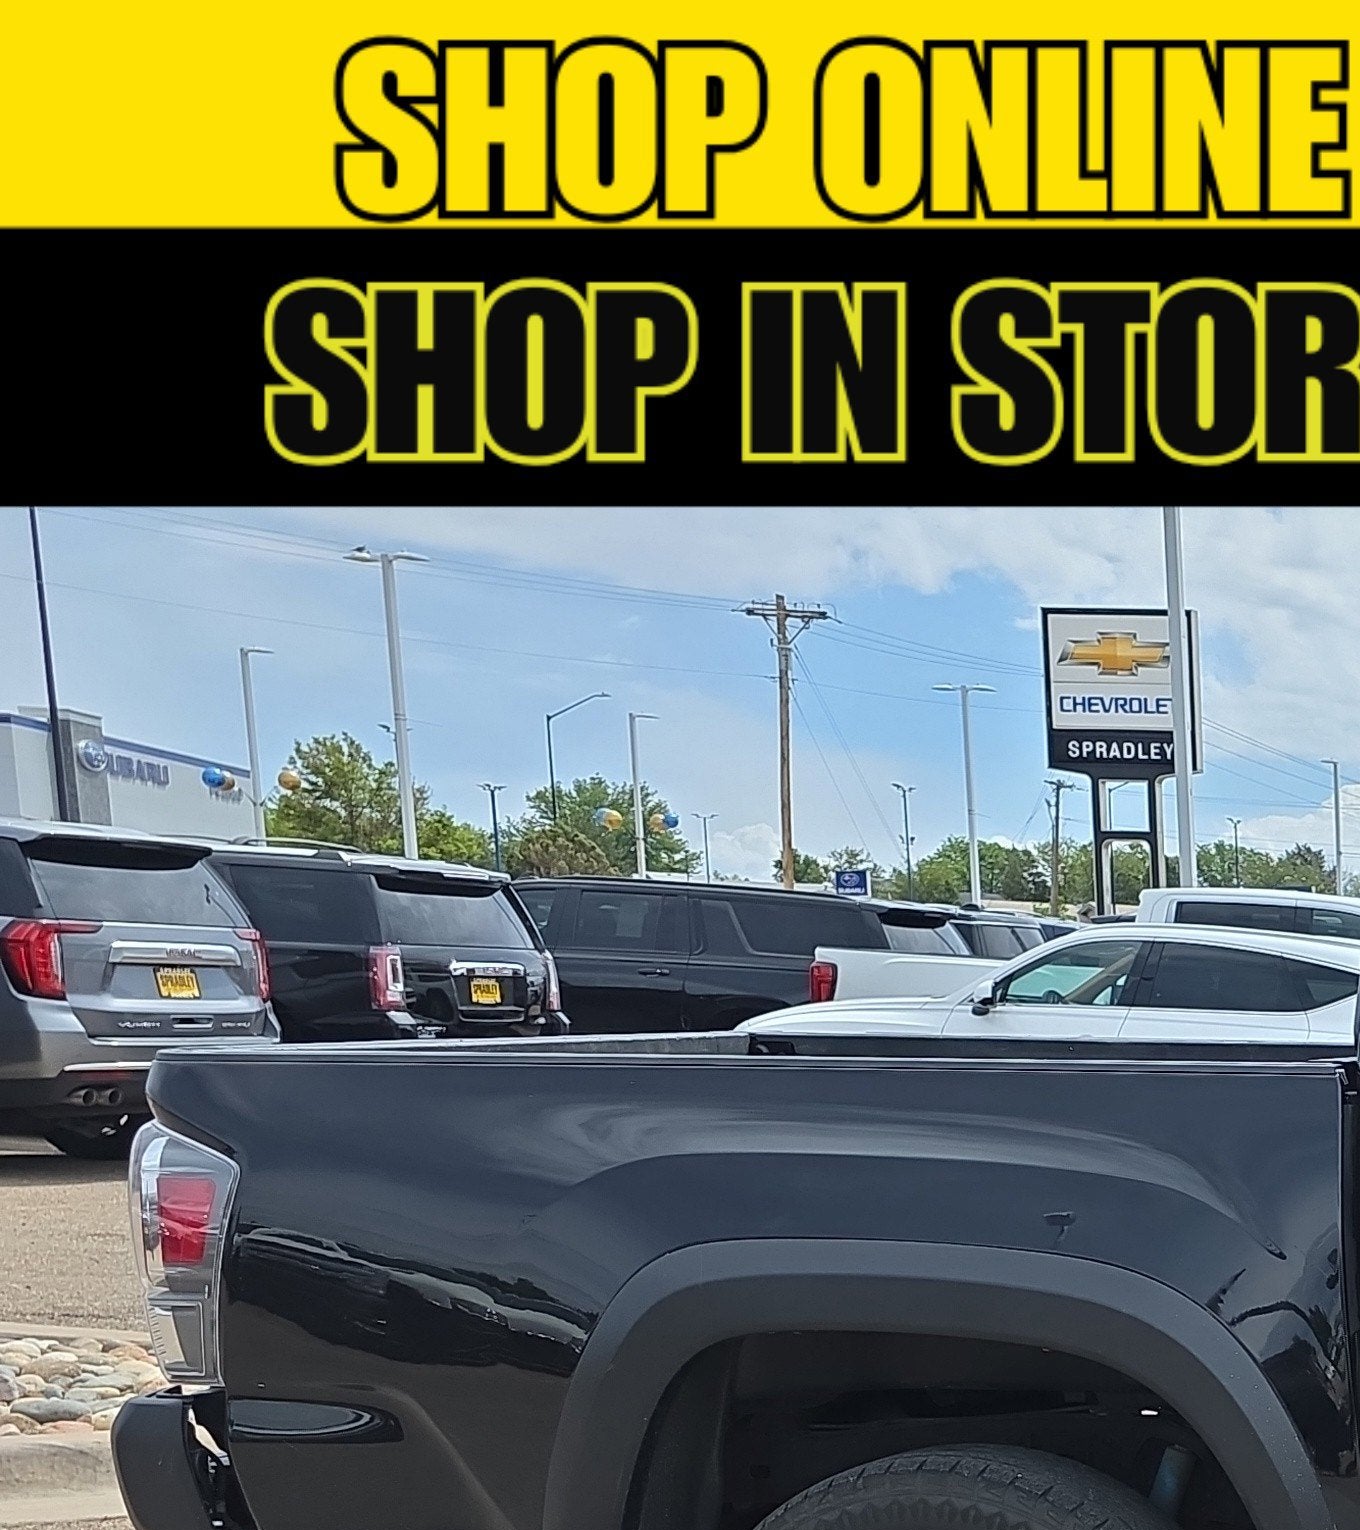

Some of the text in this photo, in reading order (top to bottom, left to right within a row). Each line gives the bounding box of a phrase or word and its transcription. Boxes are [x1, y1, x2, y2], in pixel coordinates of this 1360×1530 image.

[1059, 696, 1172, 715] CHEVROLE
[1067, 740, 1174, 760] SPRADLEY
[106, 752, 169, 786] UBARU
